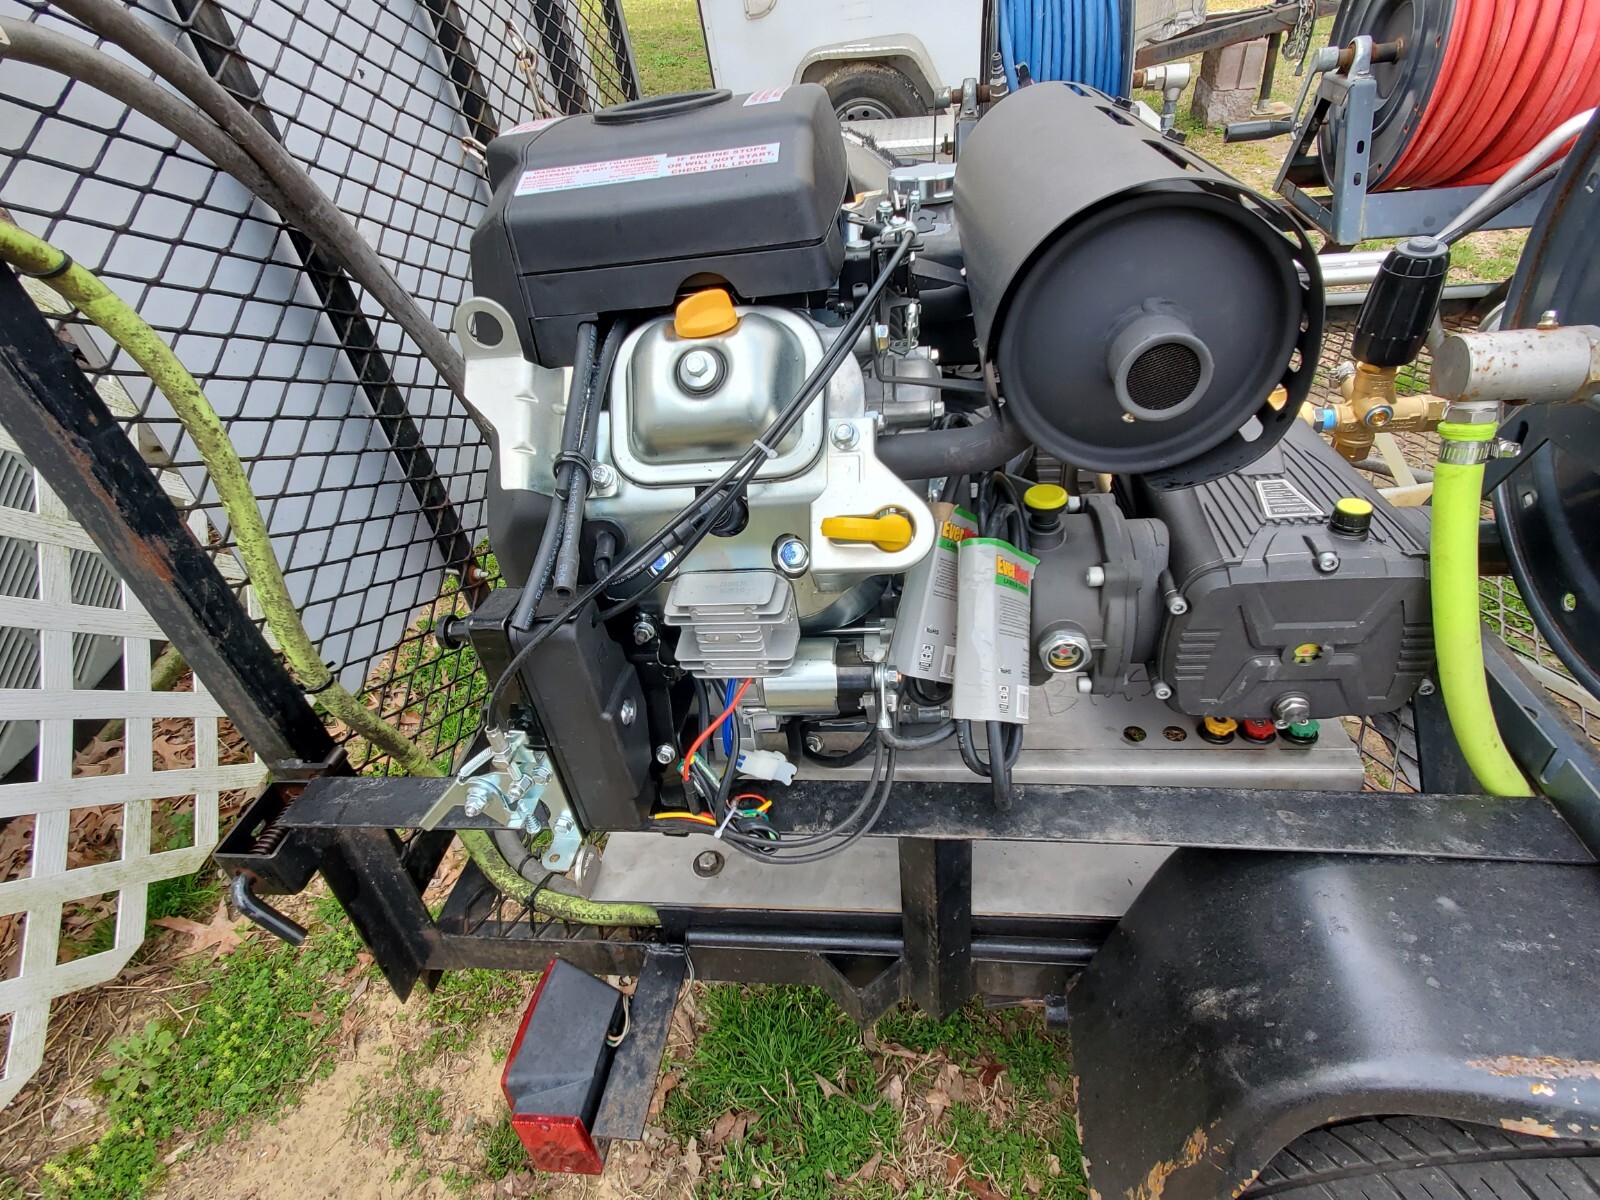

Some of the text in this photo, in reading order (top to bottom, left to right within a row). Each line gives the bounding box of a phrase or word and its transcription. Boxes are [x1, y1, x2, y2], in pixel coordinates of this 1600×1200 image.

[690, 151, 730, 161] ENGINE
[733, 145, 768, 155] STOPS
[671, 165, 707, 175] CHECK
[711, 162, 729, 170] OIL
[685, 159, 711, 168] WILL
[713, 155, 736, 164] NOT
[525, 169, 581, 181] MAINTENANCE
[592, 165, 608, 173] NOT
